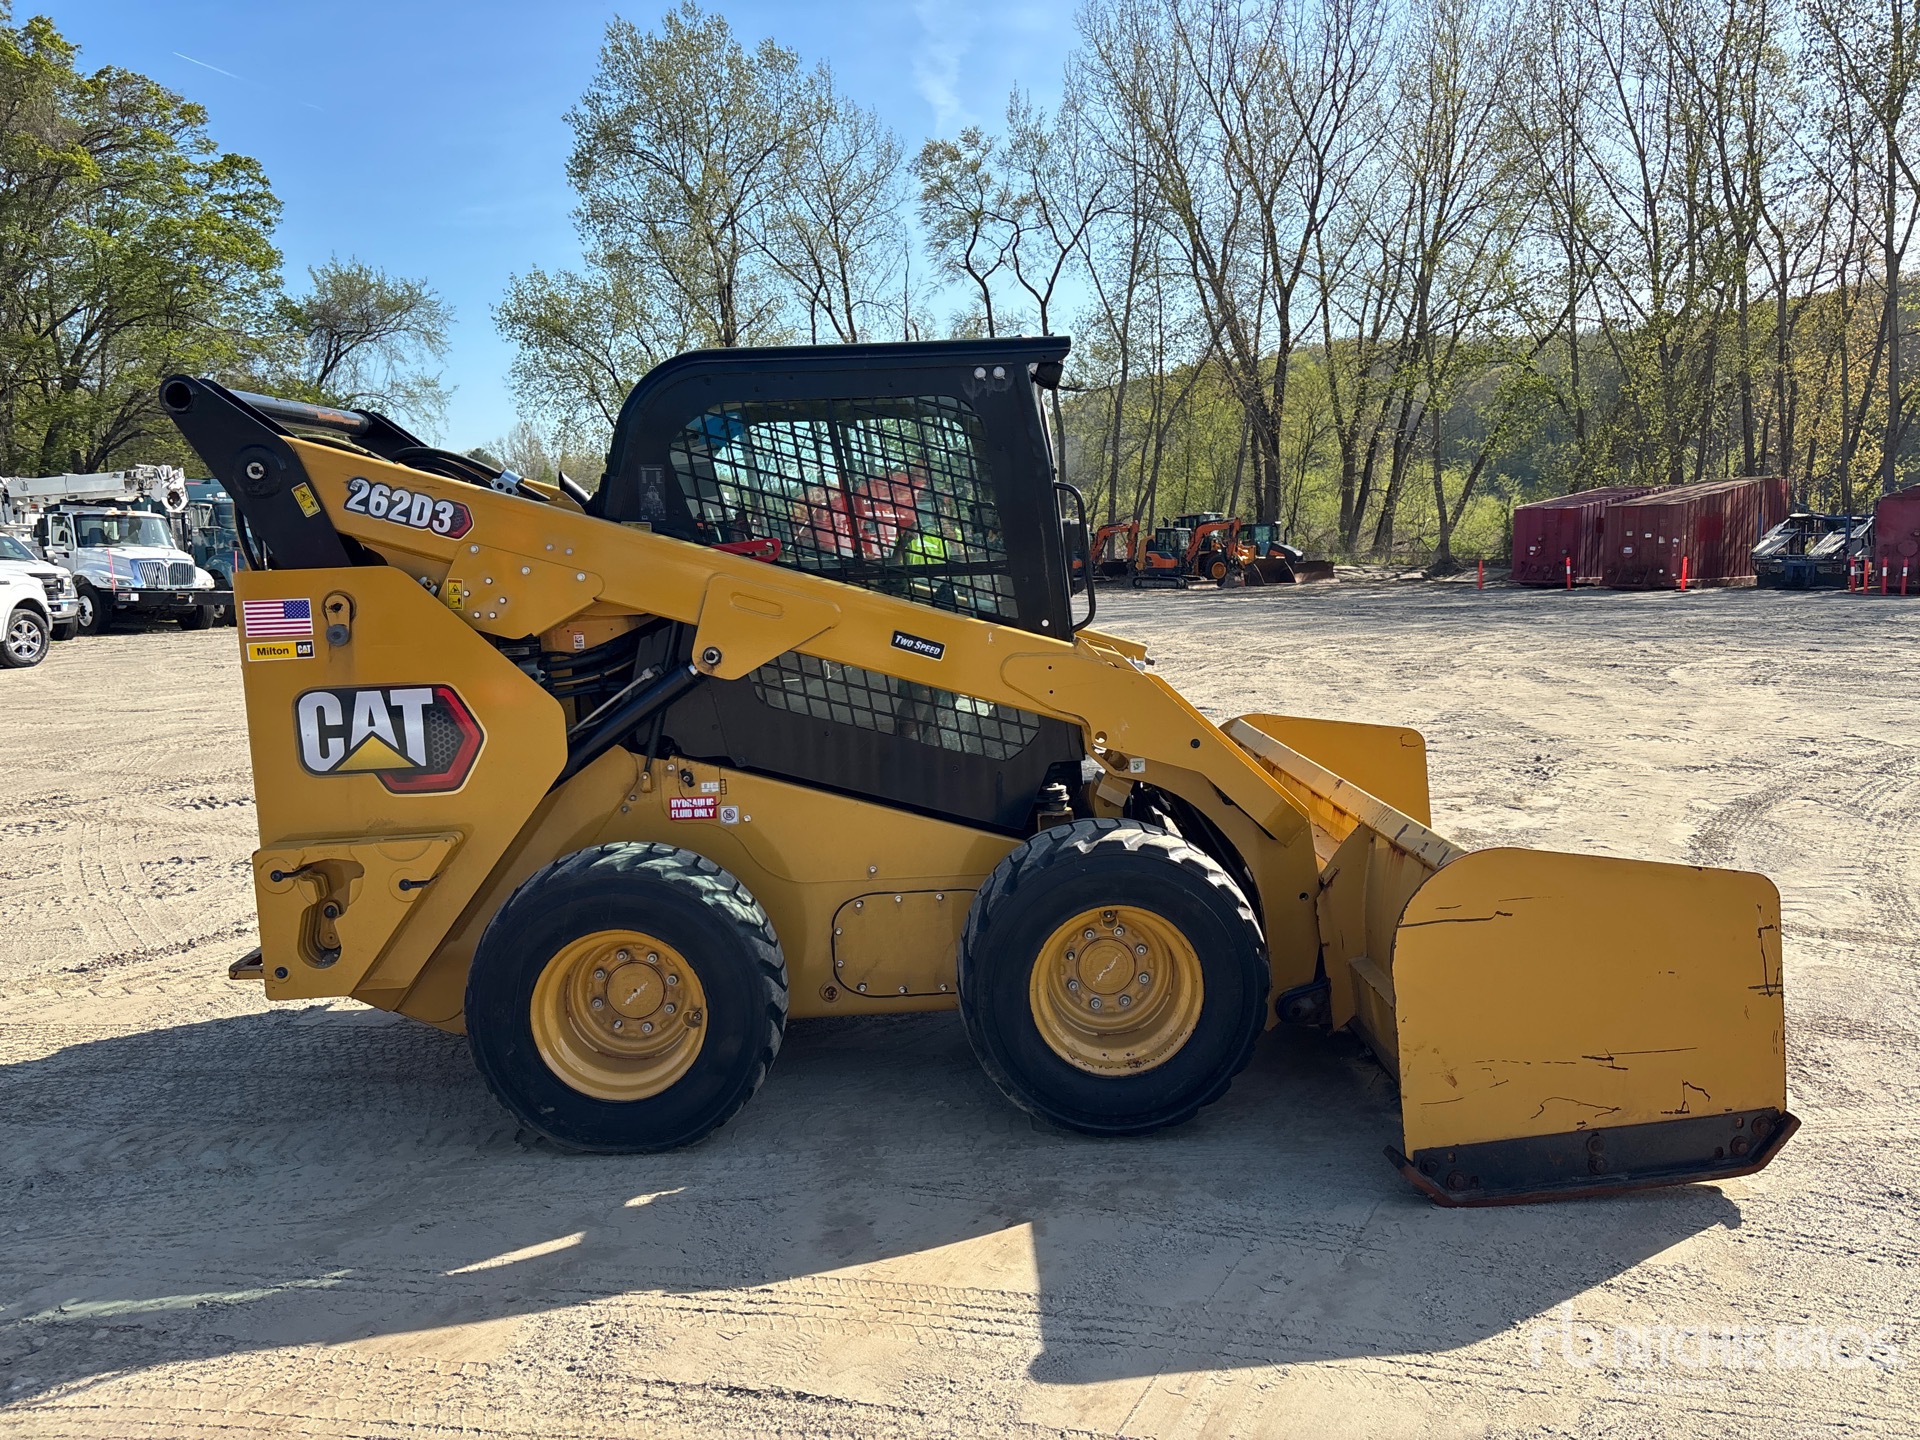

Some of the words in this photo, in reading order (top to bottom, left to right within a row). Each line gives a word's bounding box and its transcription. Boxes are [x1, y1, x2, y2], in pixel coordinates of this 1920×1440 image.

[346, 478, 454, 533] 262D3
[257, 647, 289, 656] Milton
[297, 644, 312, 654] CAT
[298, 688, 433, 772] CAT
[671, 809, 692, 818] FLUID
[694, 808, 714, 817] ONLY
